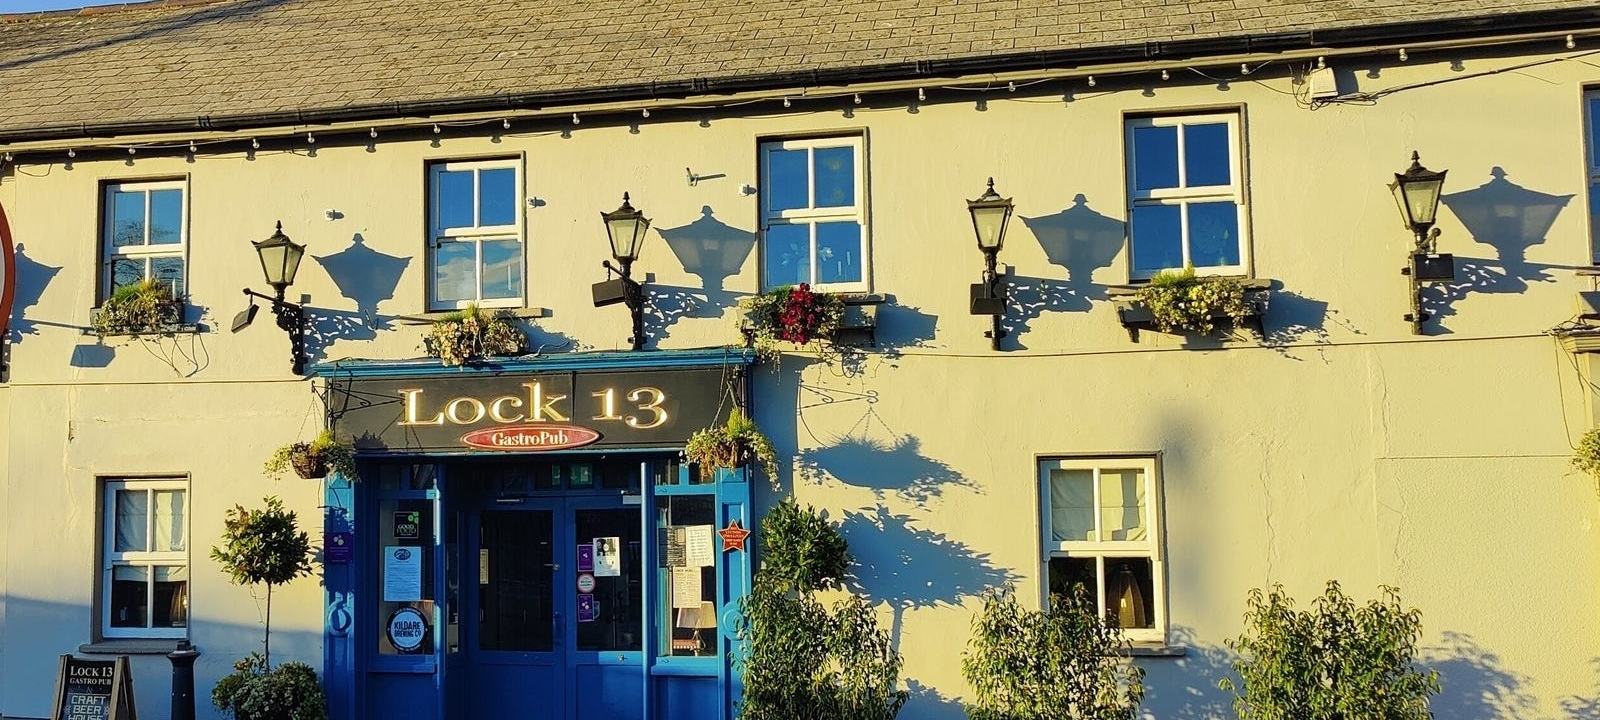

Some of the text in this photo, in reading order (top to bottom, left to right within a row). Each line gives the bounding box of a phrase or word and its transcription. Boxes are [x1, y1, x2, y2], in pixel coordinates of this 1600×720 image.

[397, 380, 668, 429] Lock 13
[491, 431, 569, 447] GastroPub
[394, 621, 421, 630] KILDARE
[70, 666, 113, 677] LOCK 13
[70, 695, 106, 705] CRAFT
[73, 705, 102, 714] BEER
